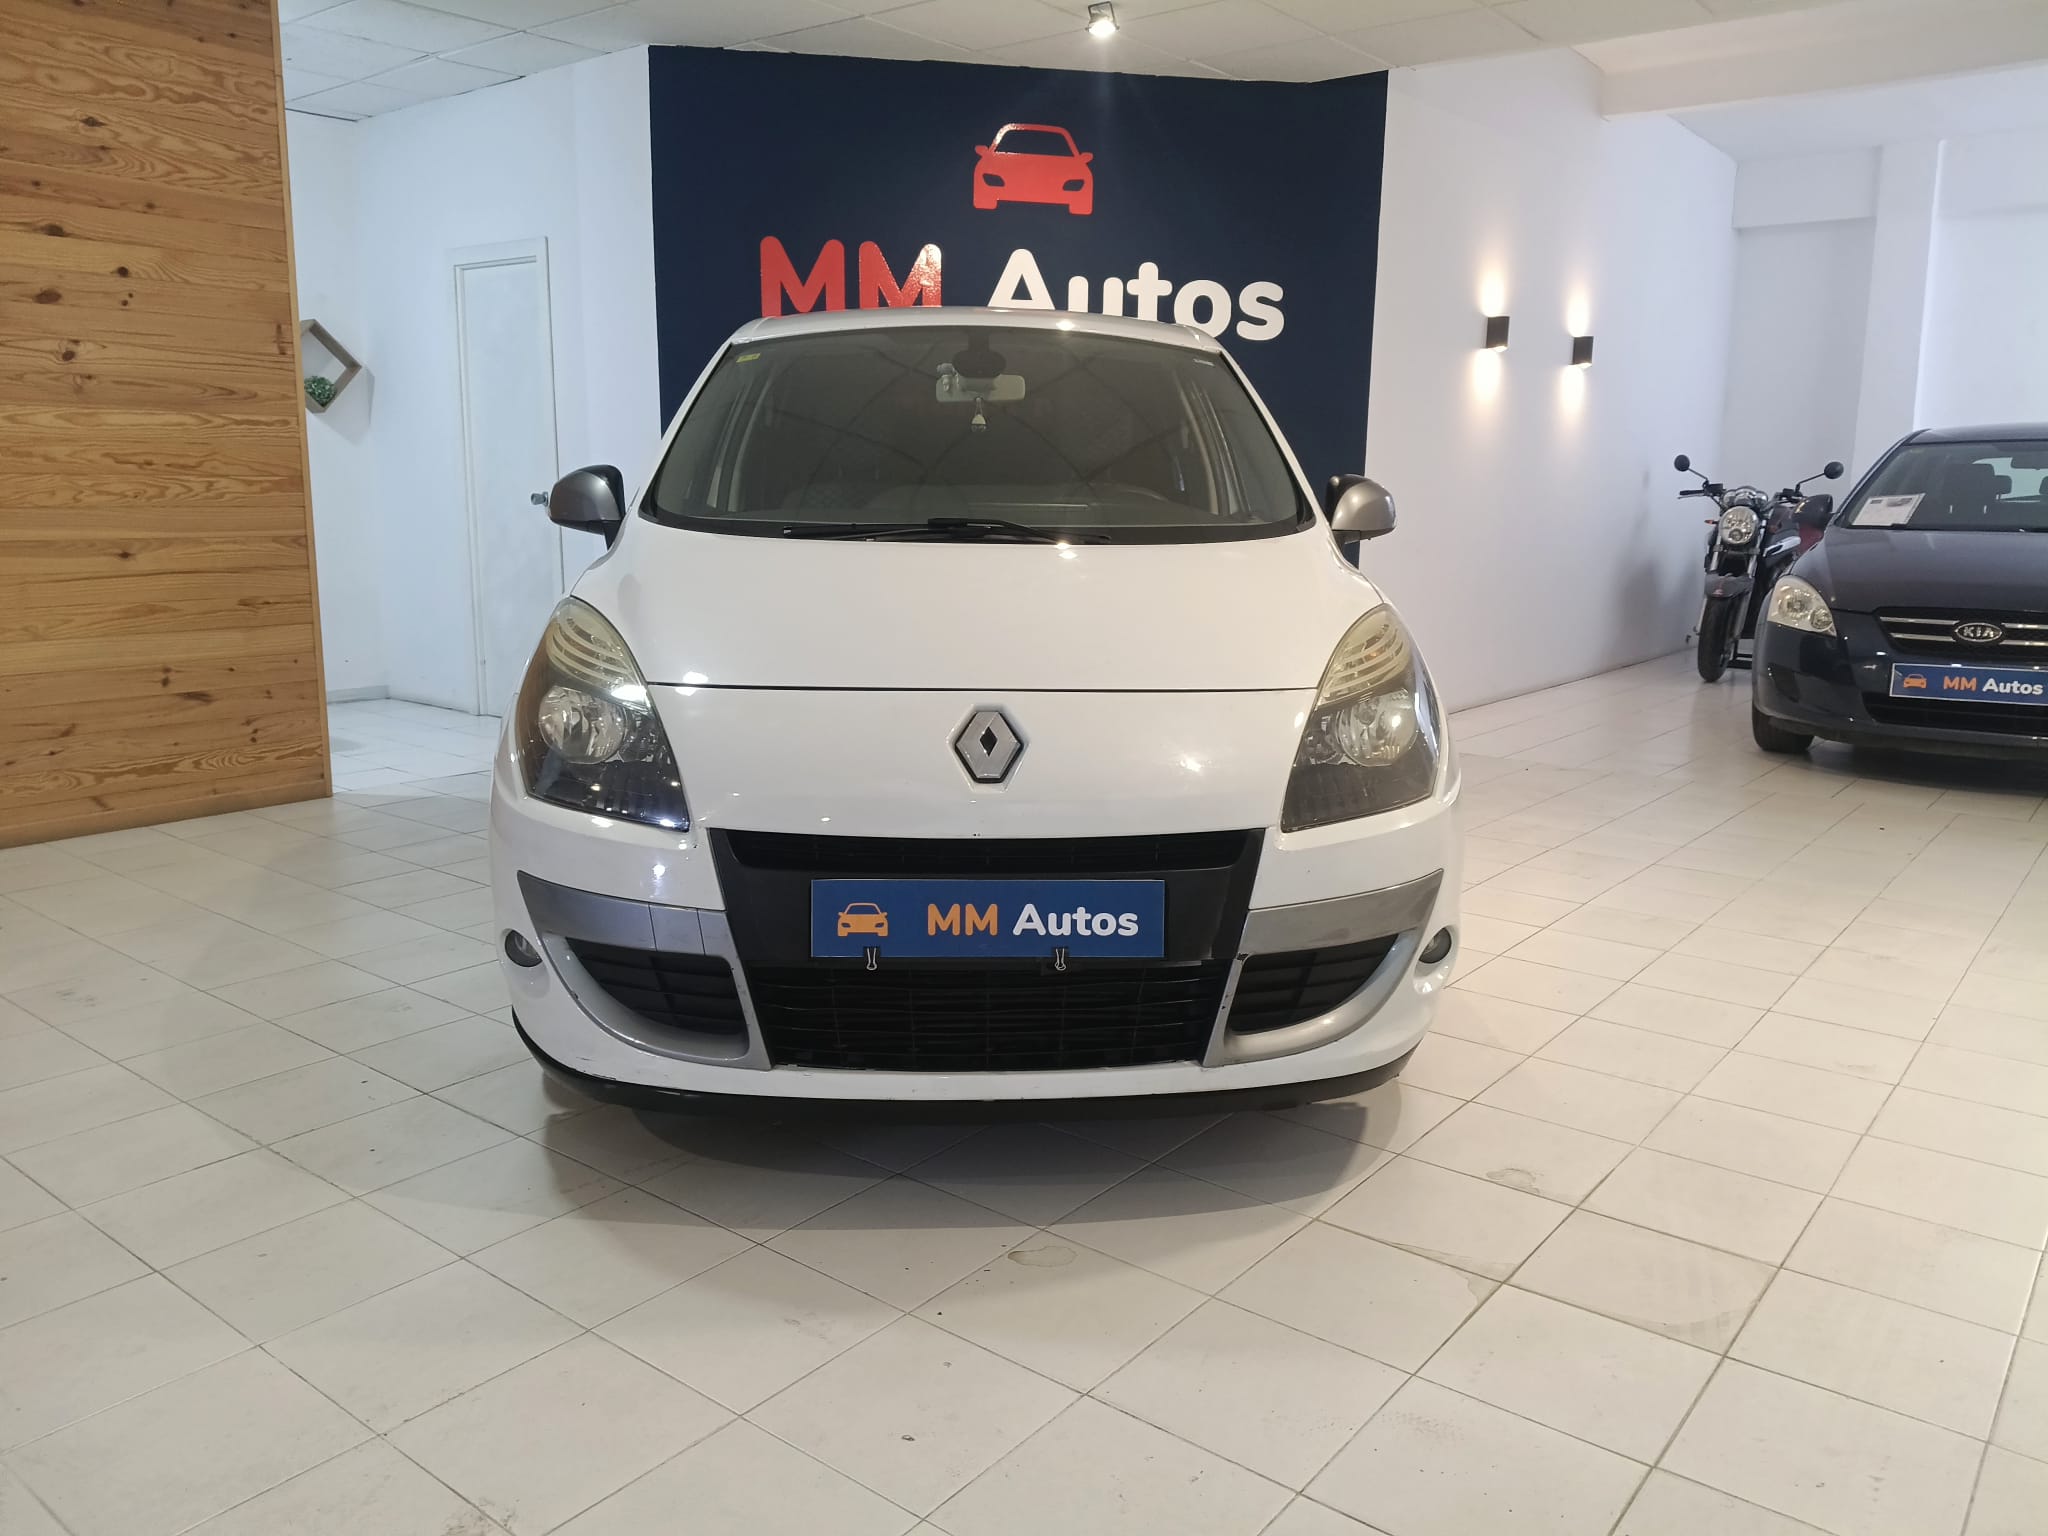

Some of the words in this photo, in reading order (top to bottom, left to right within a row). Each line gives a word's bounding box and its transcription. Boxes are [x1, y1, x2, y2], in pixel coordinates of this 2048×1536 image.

[760, 236, 943, 319] MM
[987, 248, 1285, 341] Autos
[1963, 626, 1994, 639] KIA
[1943, 676, 1977, 691] MM
[1982, 678, 2044, 696] Autos
[927, 903, 999, 937] MM
[1013, 903, 1139, 937] Autos
